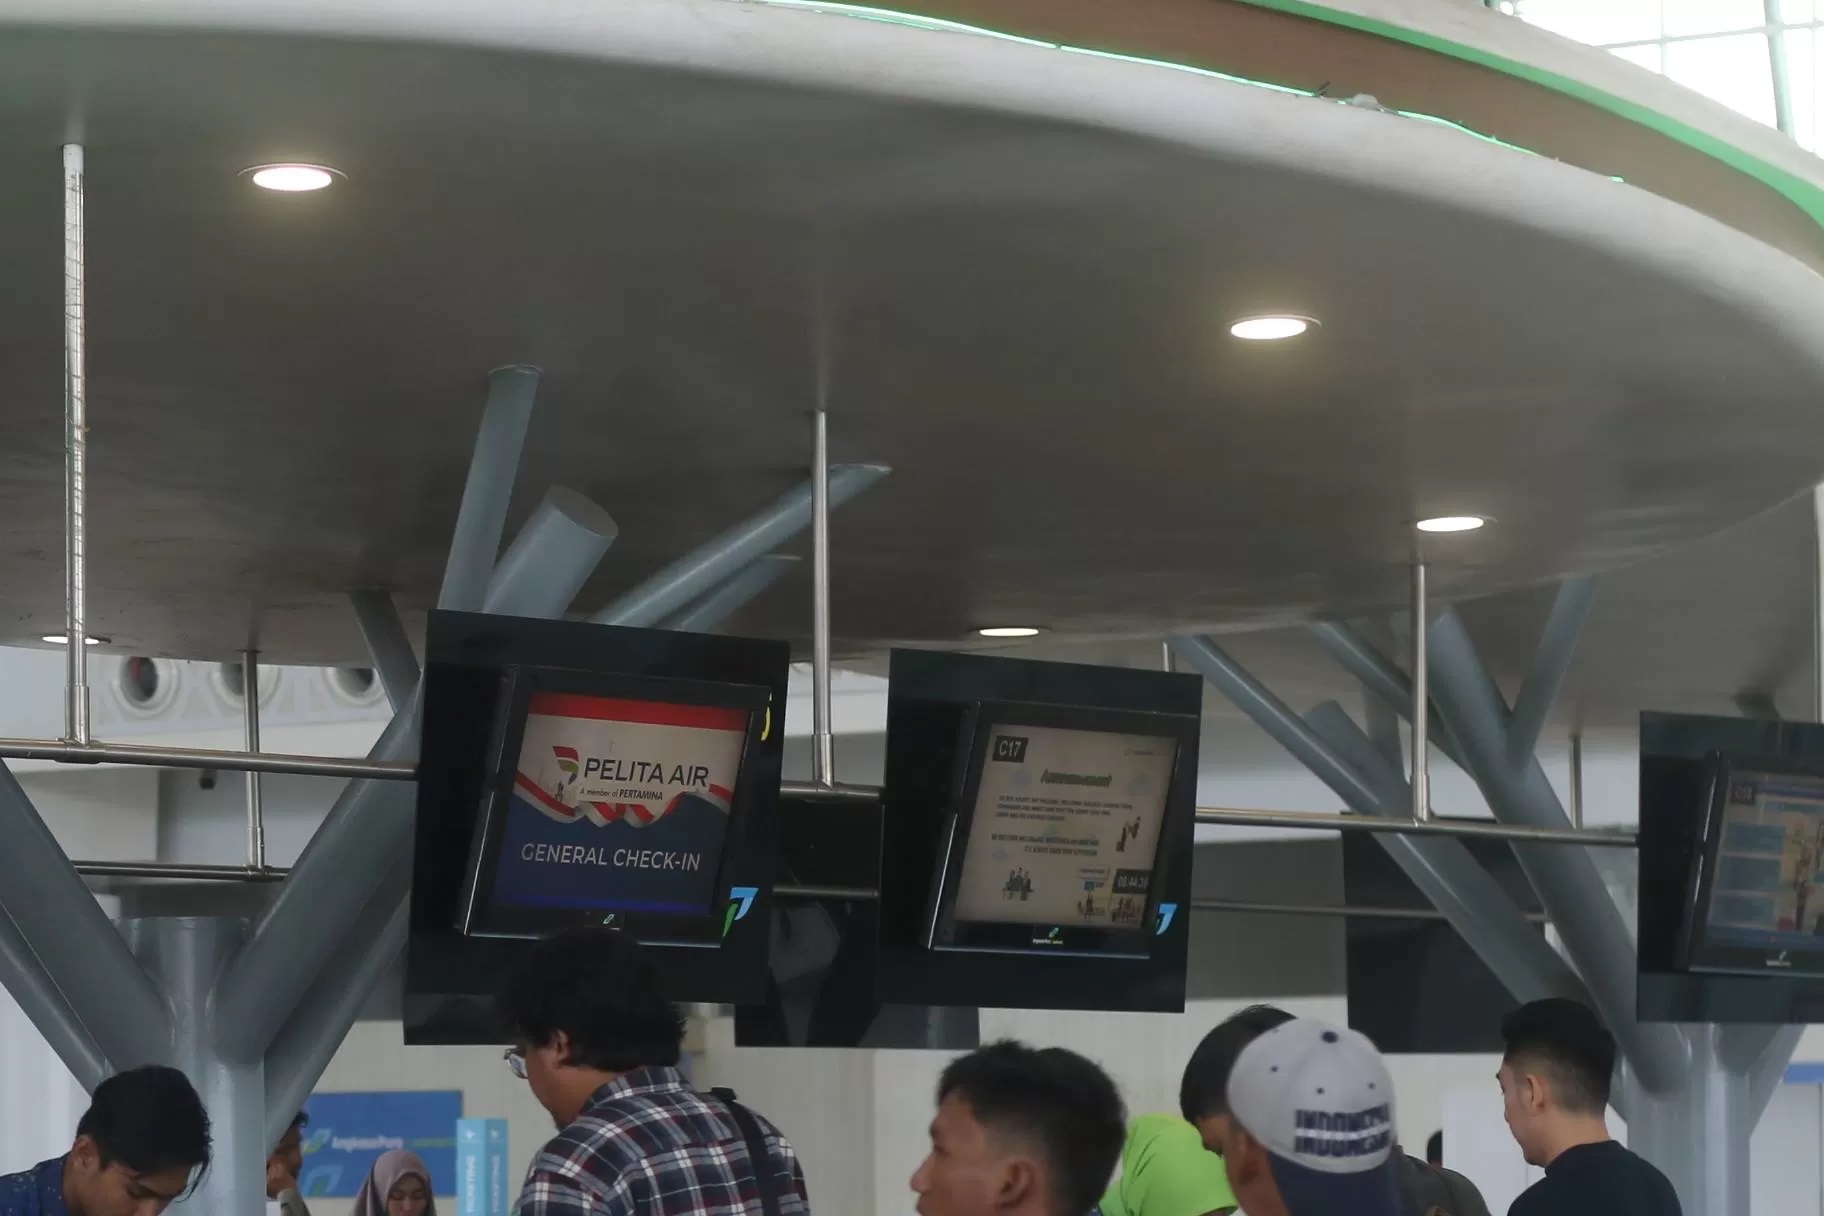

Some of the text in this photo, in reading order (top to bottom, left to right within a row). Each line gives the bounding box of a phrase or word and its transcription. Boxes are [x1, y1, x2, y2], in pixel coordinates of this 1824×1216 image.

[998, 740, 1022, 757] C17
[583, 757, 710, 787] PELITA AIR
[618, 788, 664, 801] PERTAMINA
[521, 843, 702, 872] GENERAL CHECK-IN
